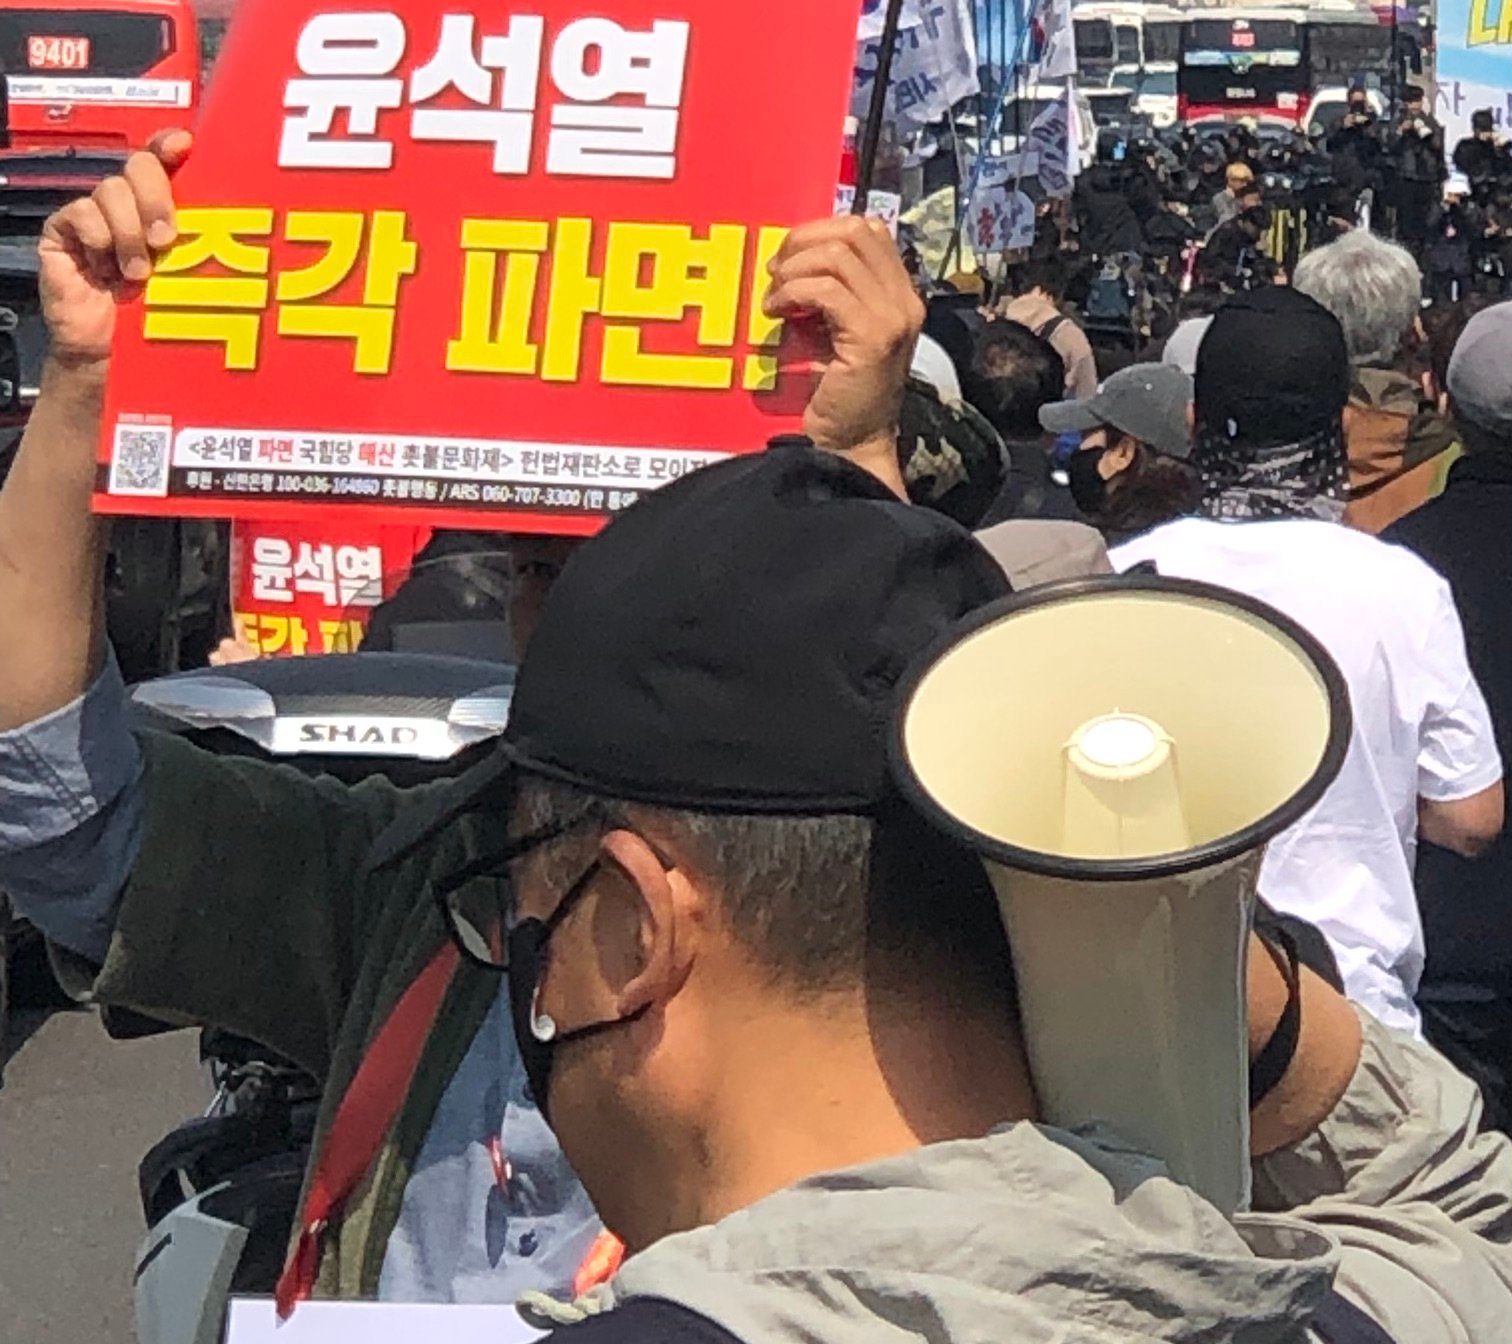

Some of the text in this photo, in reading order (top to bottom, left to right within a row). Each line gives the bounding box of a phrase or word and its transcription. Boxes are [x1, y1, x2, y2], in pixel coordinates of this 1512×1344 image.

[31, 40, 87, 66] 9401
[278, 12, 690, 179] 윤석열
[144, 207, 415, 375] 즉각
[259, 438, 294, 463] 파면
[300, 439, 353, 465] 국힘당
[521, 449, 641, 478] 헌법재판소로
[451, 483, 480, 500] ARS
[252, 537, 384, 606] 윤석열
[300, 724, 418, 745] SHAD
